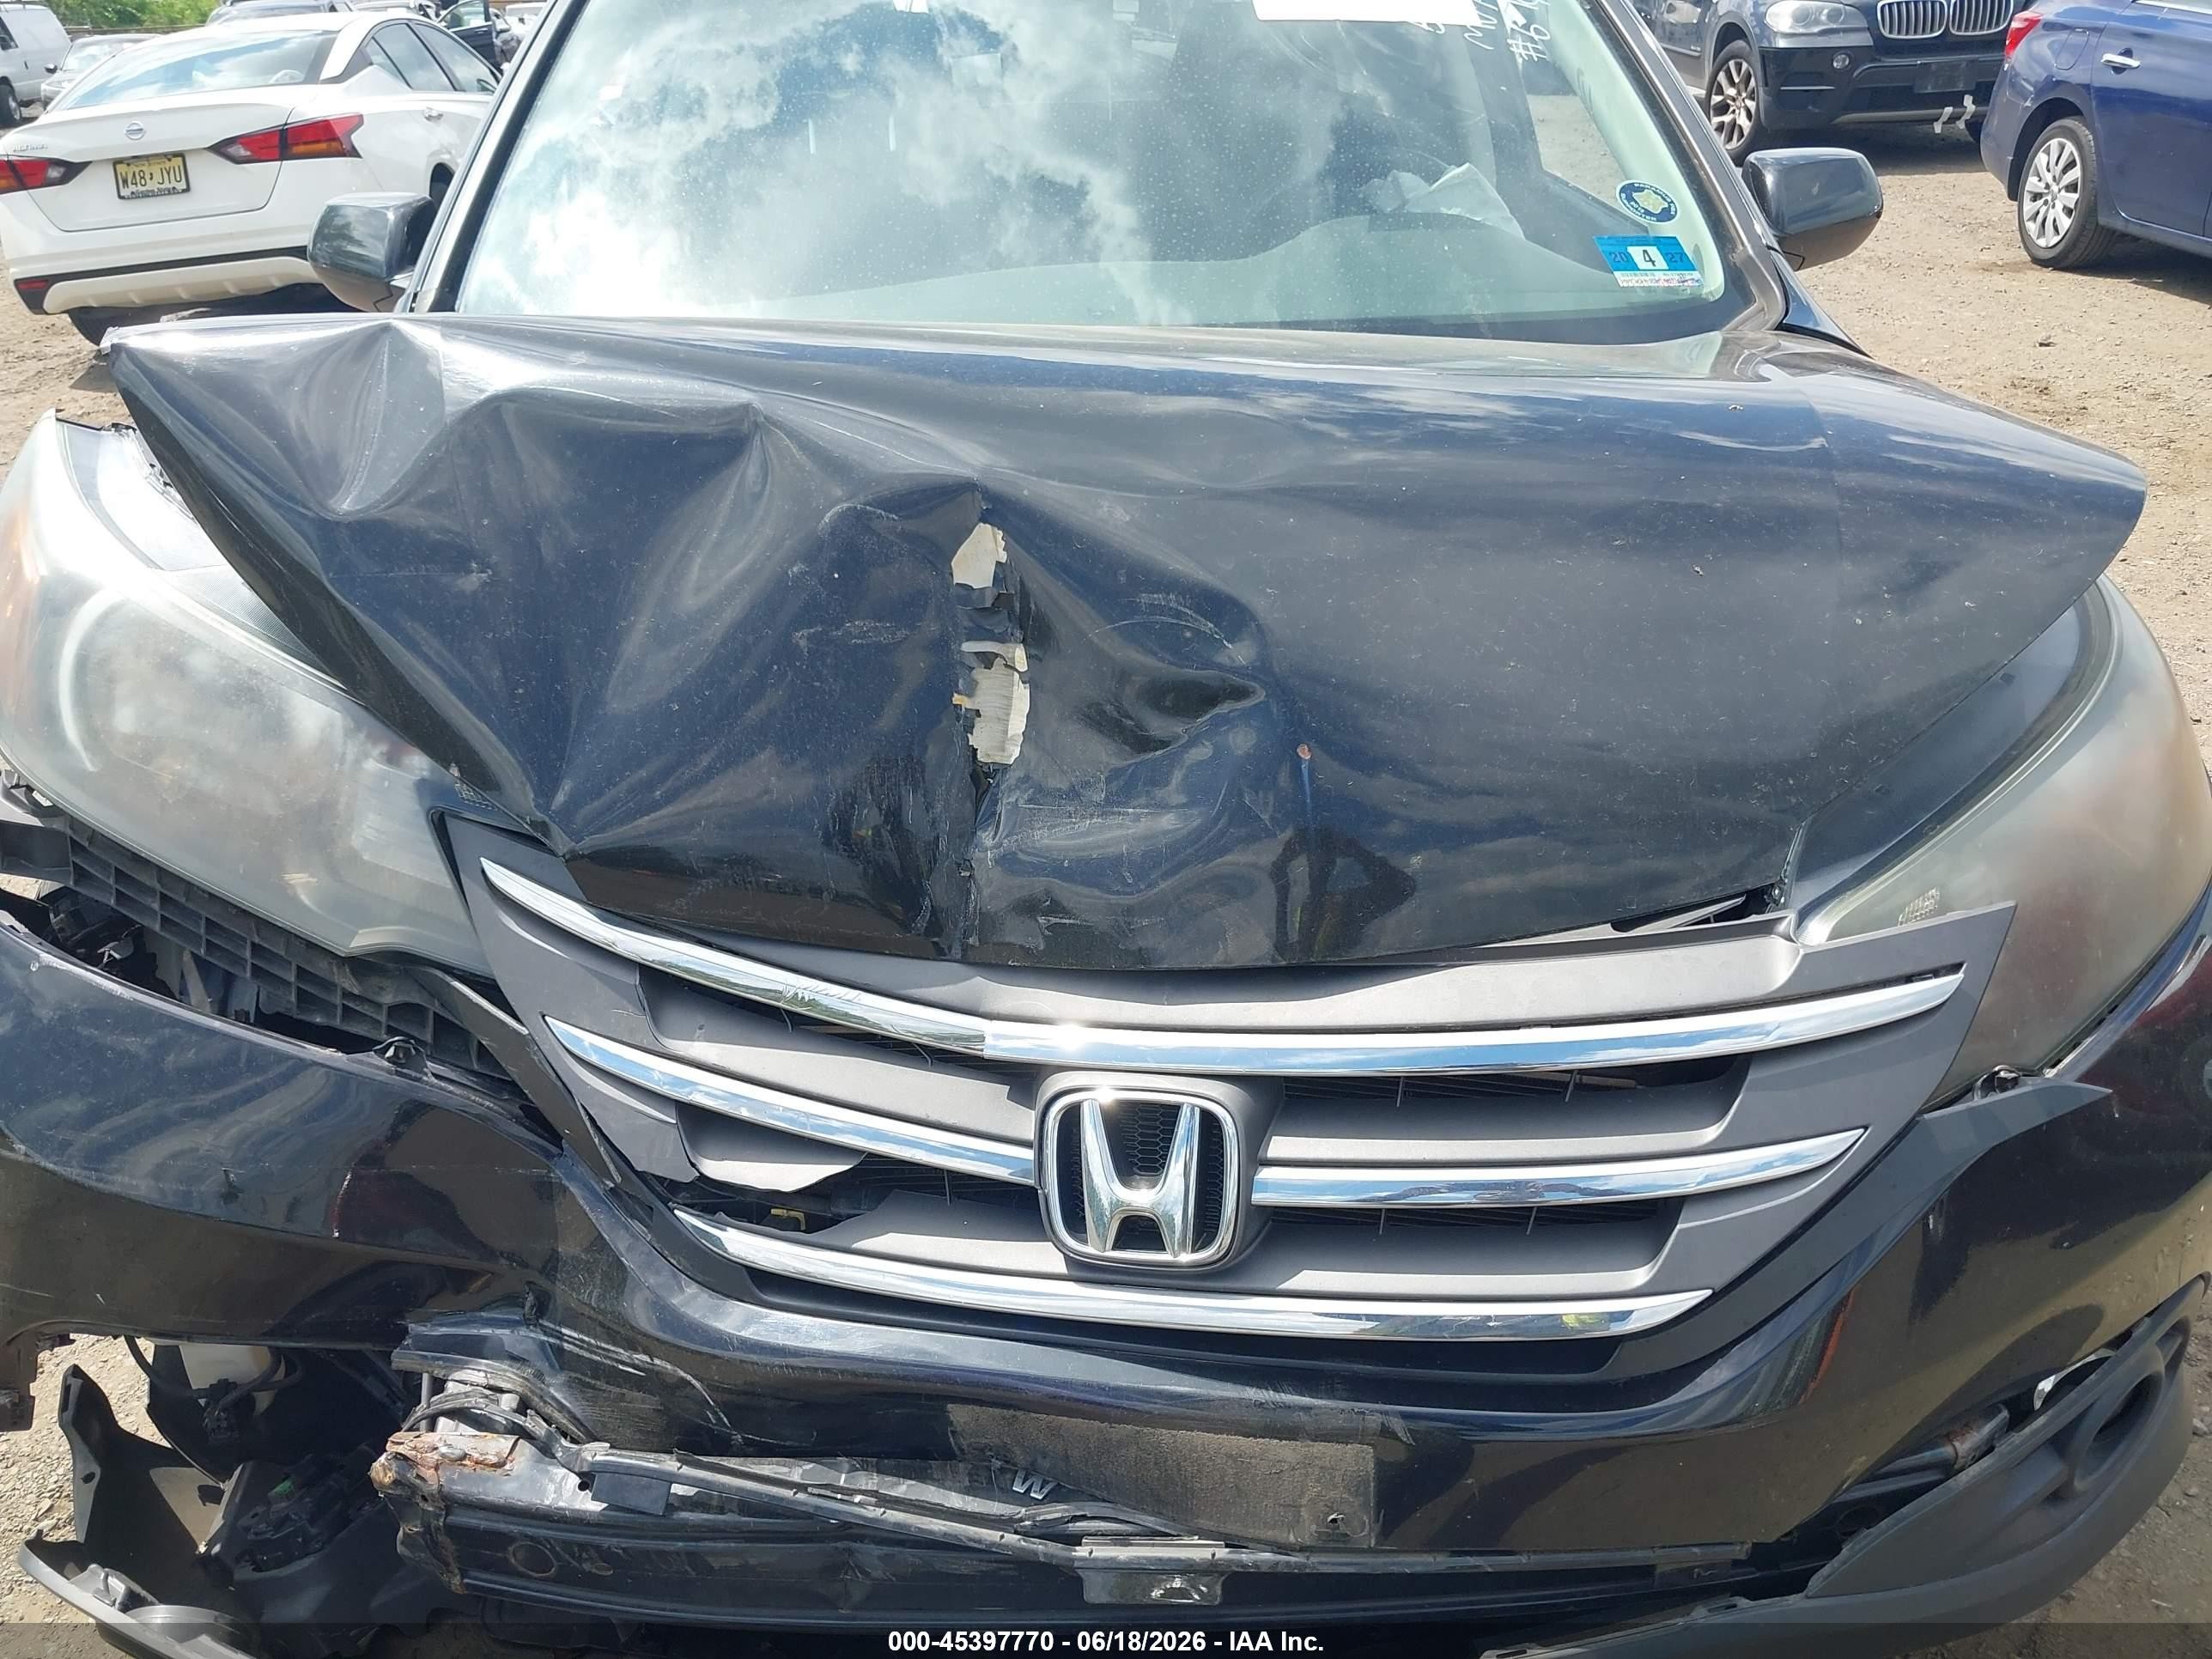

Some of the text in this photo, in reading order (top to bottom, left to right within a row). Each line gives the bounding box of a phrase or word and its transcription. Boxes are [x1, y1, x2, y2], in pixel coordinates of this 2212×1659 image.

[119, 169, 148, 190] W48
[157, 164, 183, 185] JYU
[1641, 249, 1656, 268] 4
[1667, 252, 1684, 263] 27
